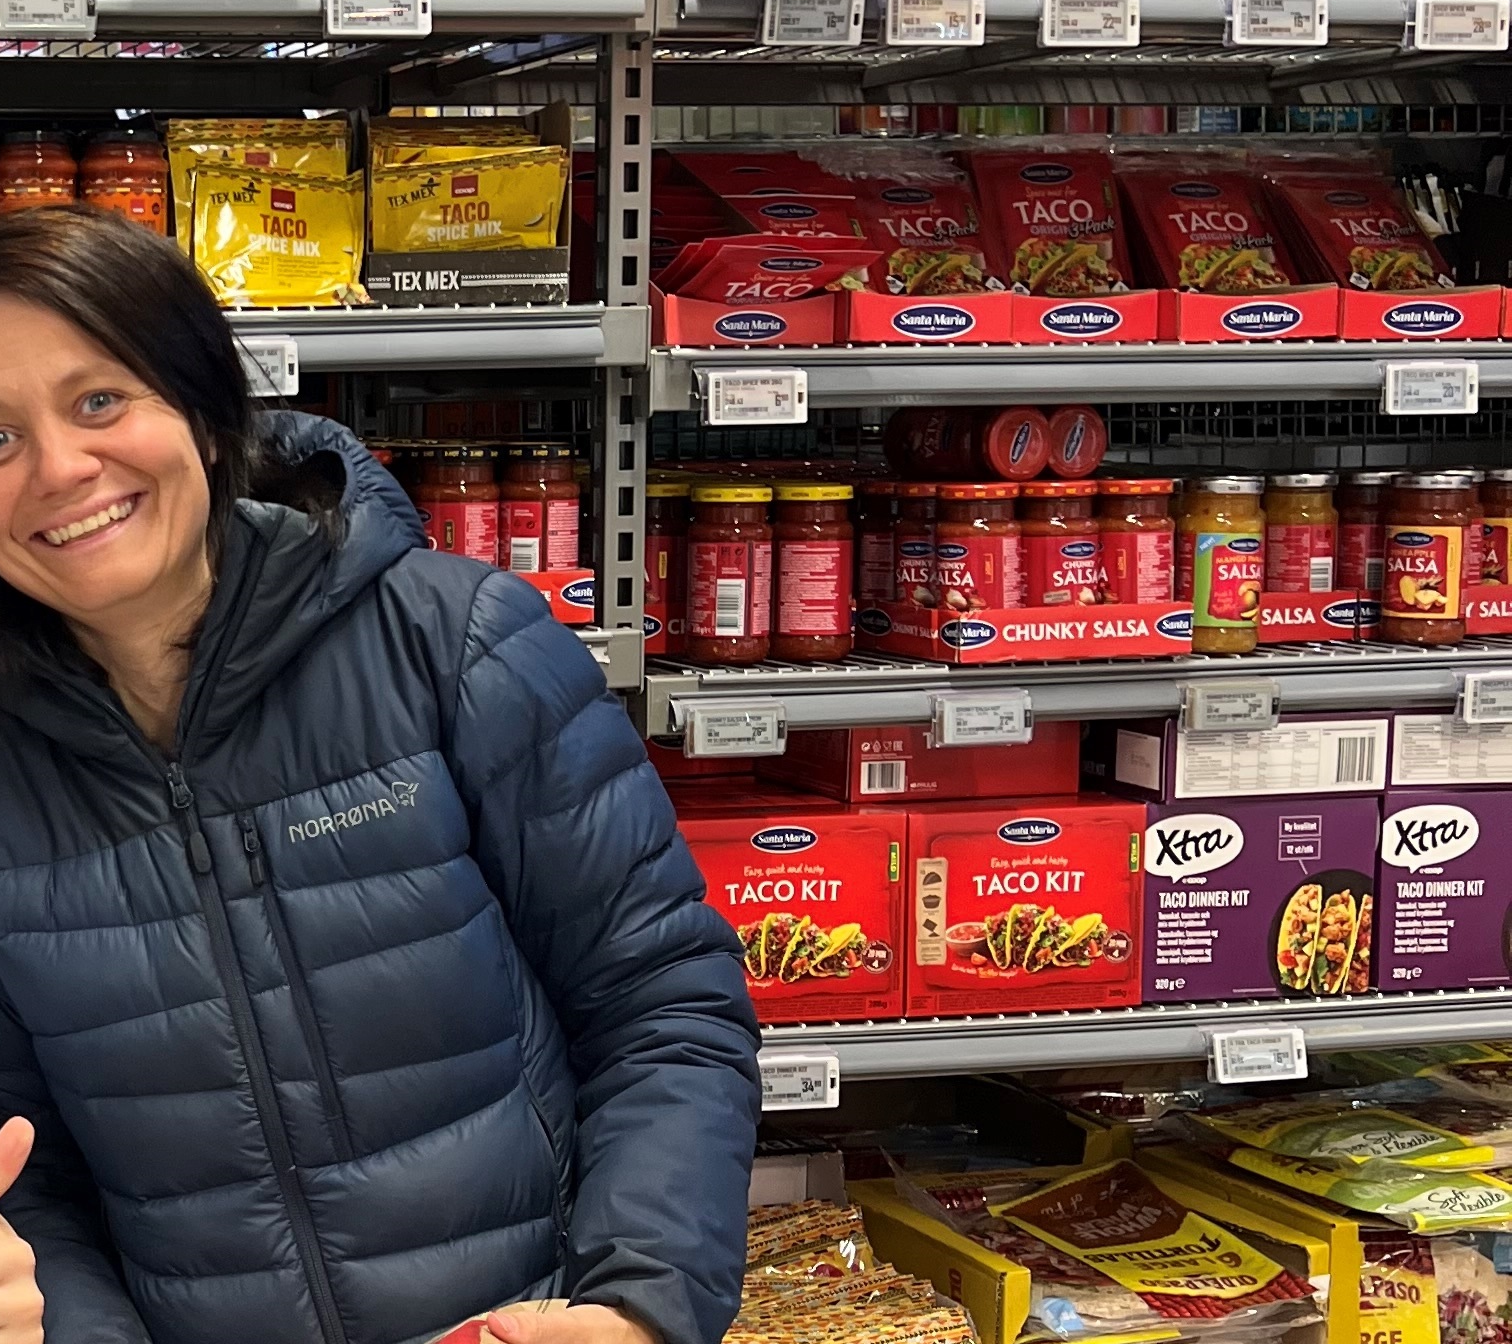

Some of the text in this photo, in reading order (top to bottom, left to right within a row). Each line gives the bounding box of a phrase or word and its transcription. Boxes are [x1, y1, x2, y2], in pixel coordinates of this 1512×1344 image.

[210, 191, 256, 205] TEX MEX
[388, 186, 435, 208] TEX MEX
[454, 186, 476, 196] coop
[273, 201, 293, 209] coop
[426, 221, 502, 243] SPICE MIX
[248, 233, 320, 257] SPICE MIX
[394, 271, 460, 291] TEX MEX
[724, 282, 815, 298] TACO
[900, 313, 965, 327] Santa Maria
[1050, 311, 1114, 325] Santa Maria
[1229, 311, 1294, 324] Santa Maria
[1390, 310, 1454, 324] Santa Maria
[720, 320, 781, 331] Santa Maria
[899, 560, 934, 568] CHUNKY
[1062, 560, 1095, 569] CHUNKY
[1388, 559, 1438, 573] SALSA
[1052, 569, 1099, 585] SALSA
[1218, 565, 1261, 580] SALSA
[1262, 609, 1316, 625] SALSA
[1327, 607, 1354, 618] Santa
[1002, 620, 1149, 642] CHUNKY SALSA
[1161, 620, 1189, 630] Santa
[288, 798, 396, 843] NORRØNA
[1394, 818, 1469, 856] Xtra
[1156, 827, 1233, 866] Xtra
[973, 871, 1085, 896] TACO KIT
[1397, 880, 1484, 897] TACO DINNER KIT
[725, 879, 842, 905] TACO KIT
[1159, 890, 1249, 907] TACO DINNER KIT
[1428, 1189, 1470, 1209] Soft
[1141, 1252, 1242, 1270] 6 LARGE
